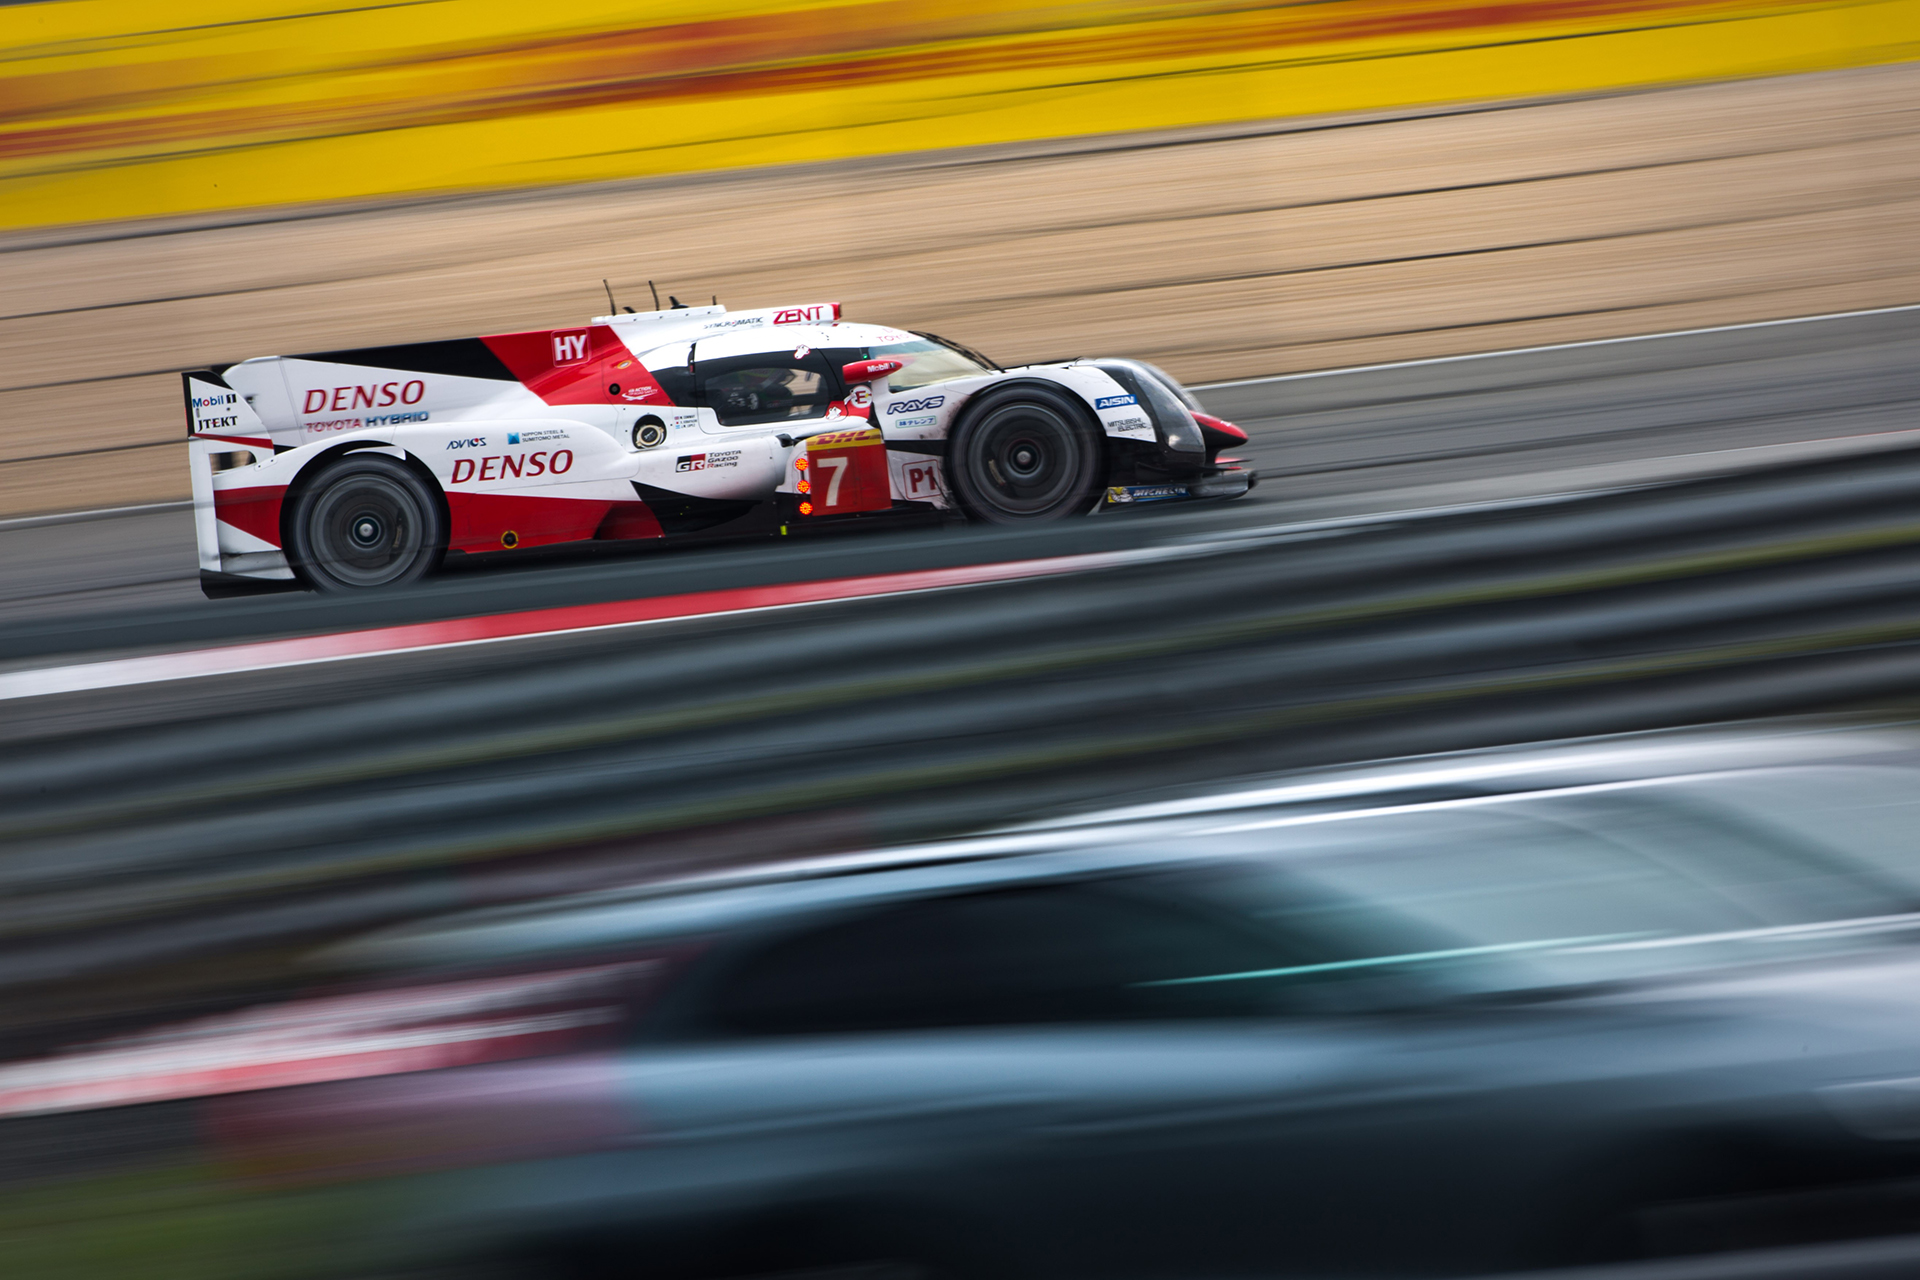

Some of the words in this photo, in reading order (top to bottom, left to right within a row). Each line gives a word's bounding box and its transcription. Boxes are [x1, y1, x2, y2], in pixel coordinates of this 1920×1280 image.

[773, 306, 824, 325] ZENT
[554, 334, 587, 362] HY
[867, 363, 889, 372] Mobil
[192, 395, 224, 408] Mobil
[302, 380, 425, 414] DENSO
[856, 390, 867, 404] E
[1099, 396, 1135, 408] AISIN
[887, 395, 945, 415] RAYS
[198, 415, 238, 432] JTEKT
[304, 418, 363, 433] TOYOTA
[365, 411, 429, 427] HYBRID
[522, 435, 551, 443] SUMITOMO
[816, 431, 871, 445] DHL
[708, 450, 742, 458] TOYOTA
[451, 449, 573, 484] DENSO
[676, 460, 706, 472] GR
[817, 457, 848, 507] 7
[909, 466, 936, 493] P1
[1133, 487, 1187, 497] MICHELIN
